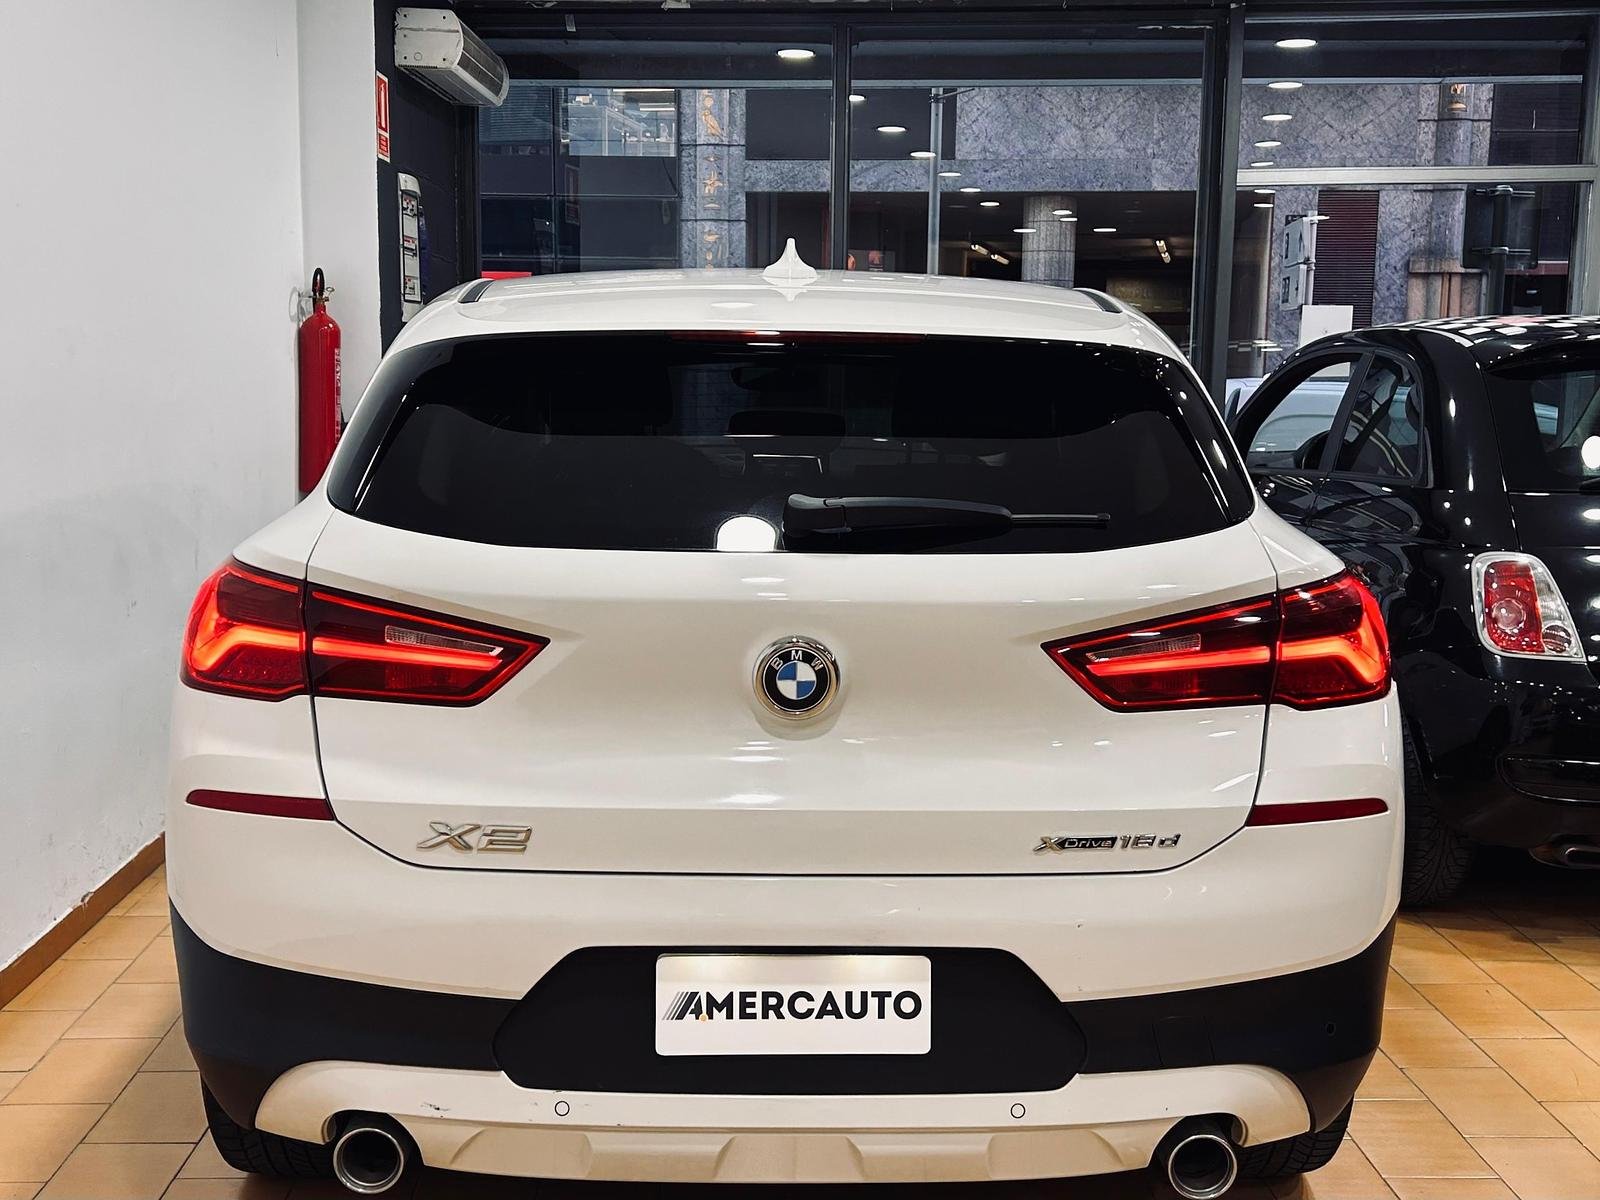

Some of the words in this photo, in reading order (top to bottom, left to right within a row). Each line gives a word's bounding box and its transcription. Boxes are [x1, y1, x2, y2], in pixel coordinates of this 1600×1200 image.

[770, 649, 824, 671] BMW
[416, 821, 532, 853] X2
[662, 990, 922, 1020] AMERCAUTO
